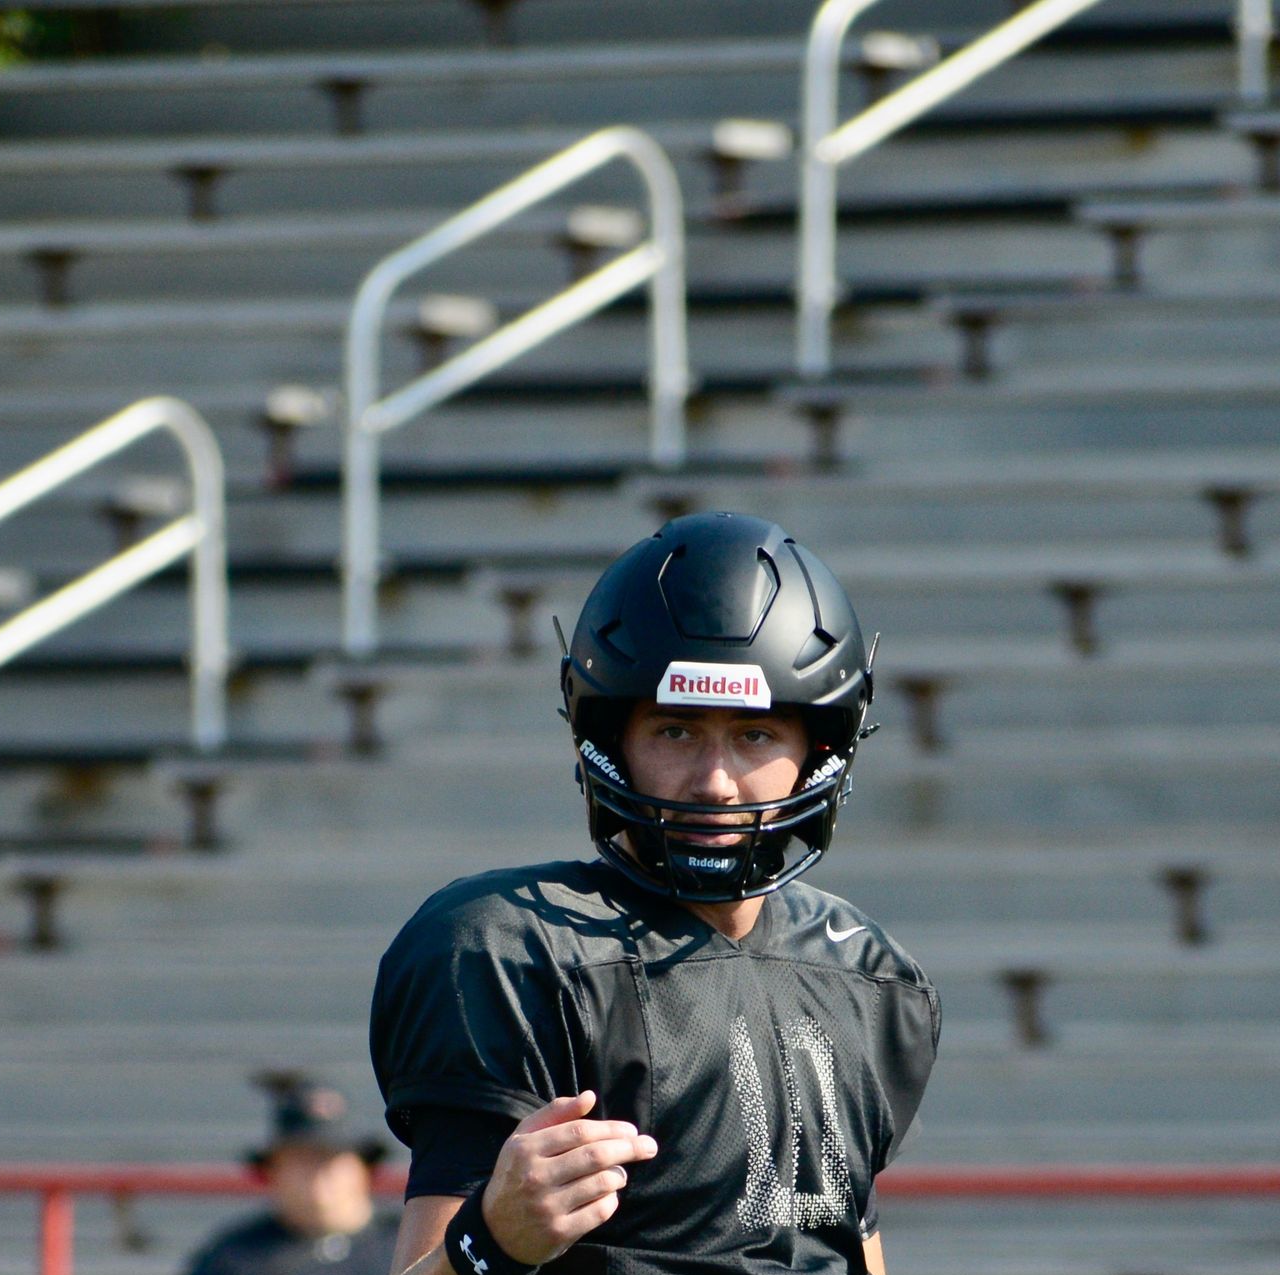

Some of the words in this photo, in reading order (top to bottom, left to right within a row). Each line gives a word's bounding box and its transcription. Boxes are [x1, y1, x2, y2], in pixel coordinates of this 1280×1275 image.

[669, 674, 759, 696] Riddell
[579, 739, 626, 787] Ridde
[801, 754, 843, 790] ddell
[729, 1013, 852, 1233] 10
